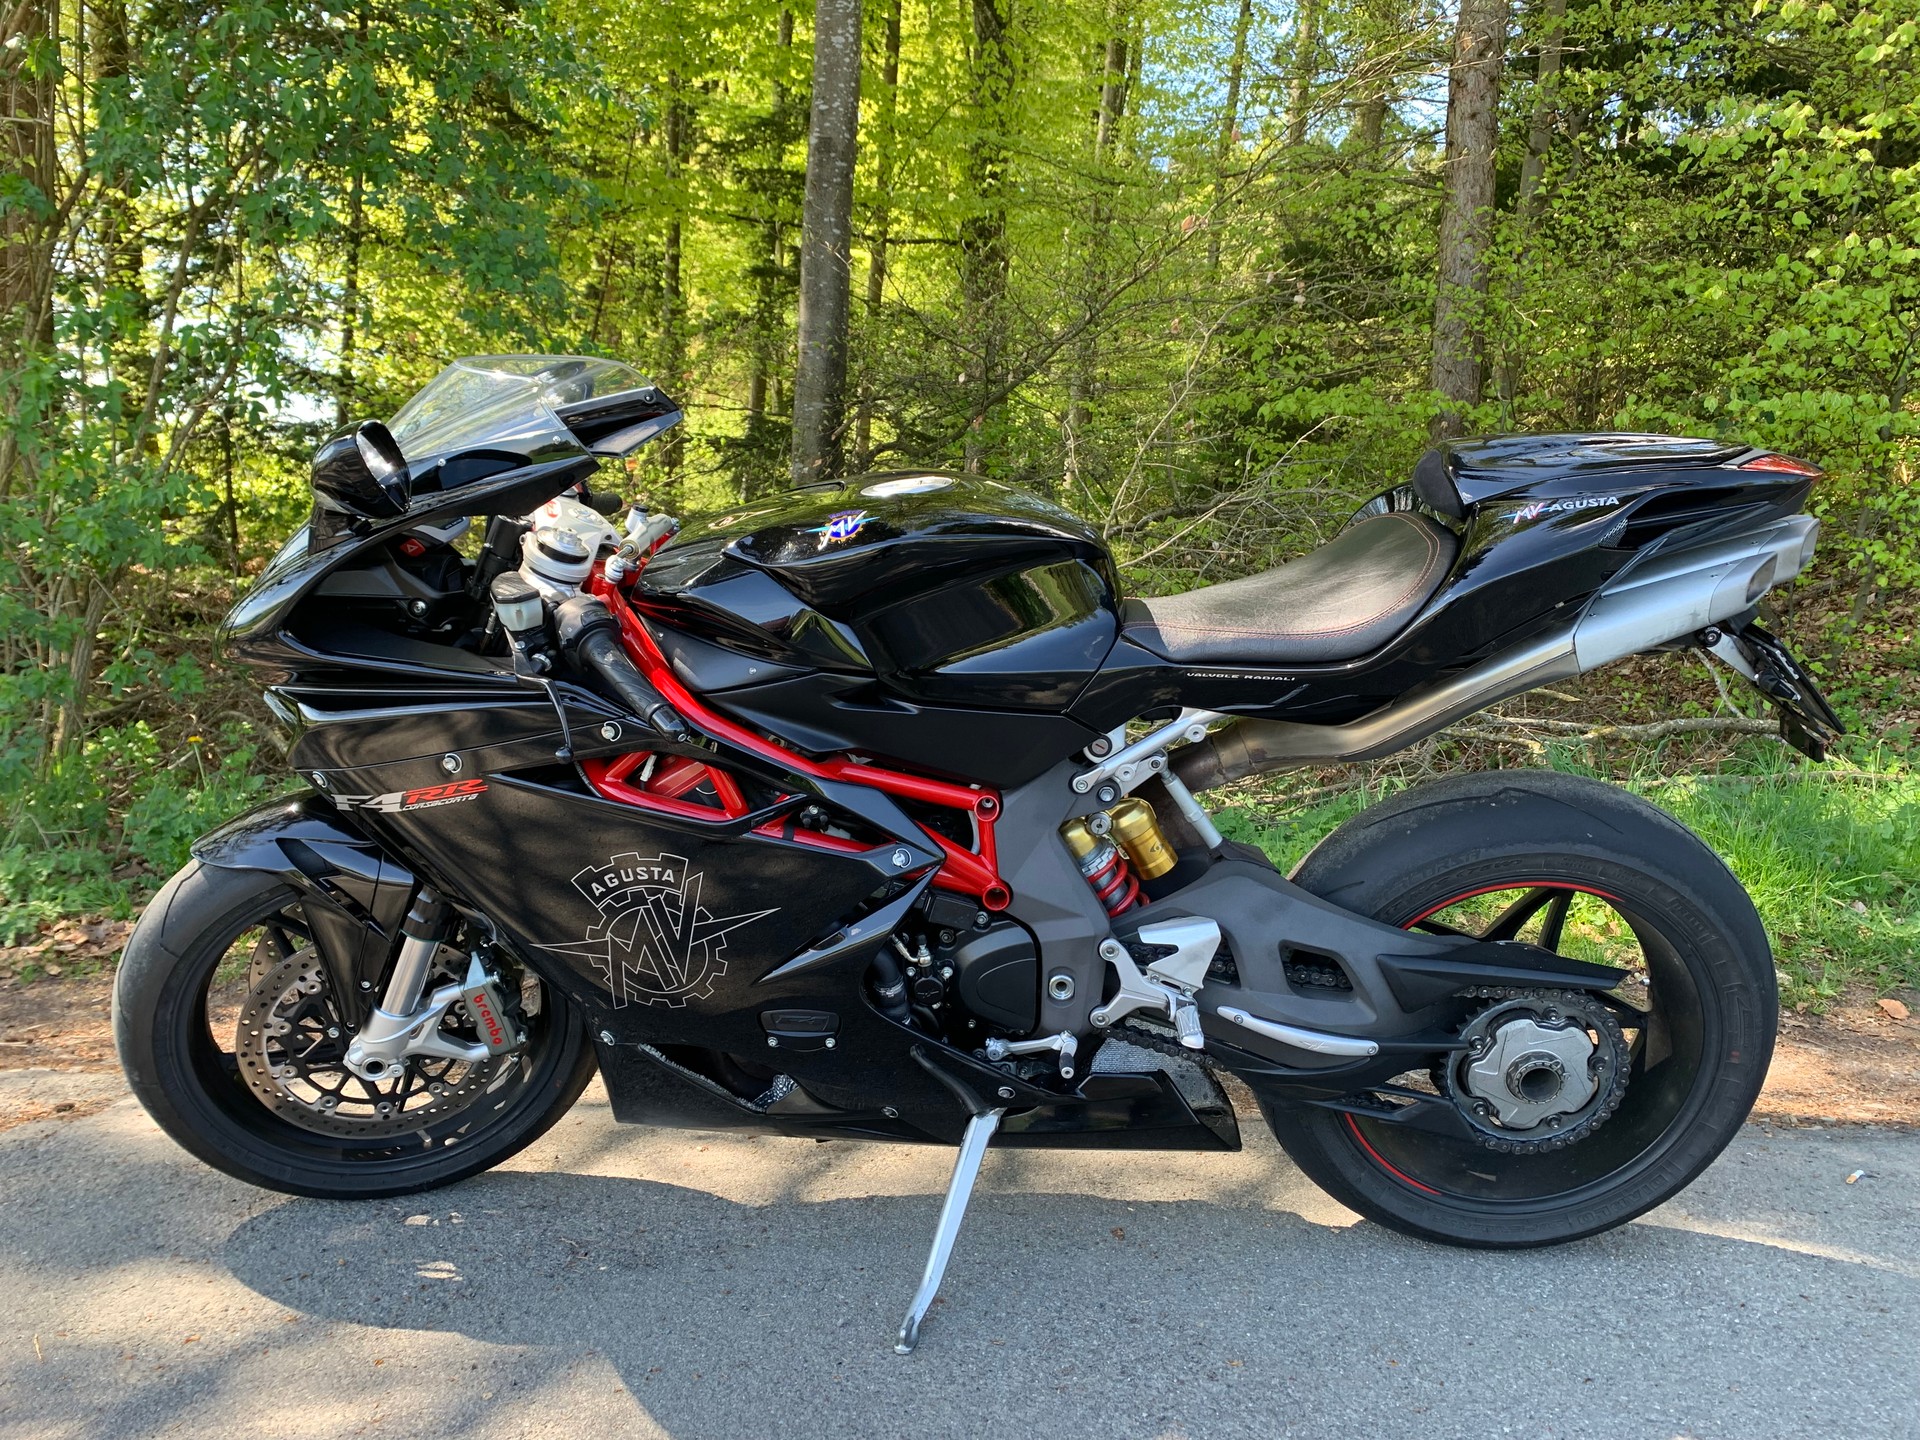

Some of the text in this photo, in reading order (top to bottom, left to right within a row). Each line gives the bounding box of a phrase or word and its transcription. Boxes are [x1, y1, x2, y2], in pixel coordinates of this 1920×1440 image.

[1549, 496, 1620, 512] AGUSTA
[590, 866, 675, 897] AGUSTA
[473, 993, 503, 1046] brembo
